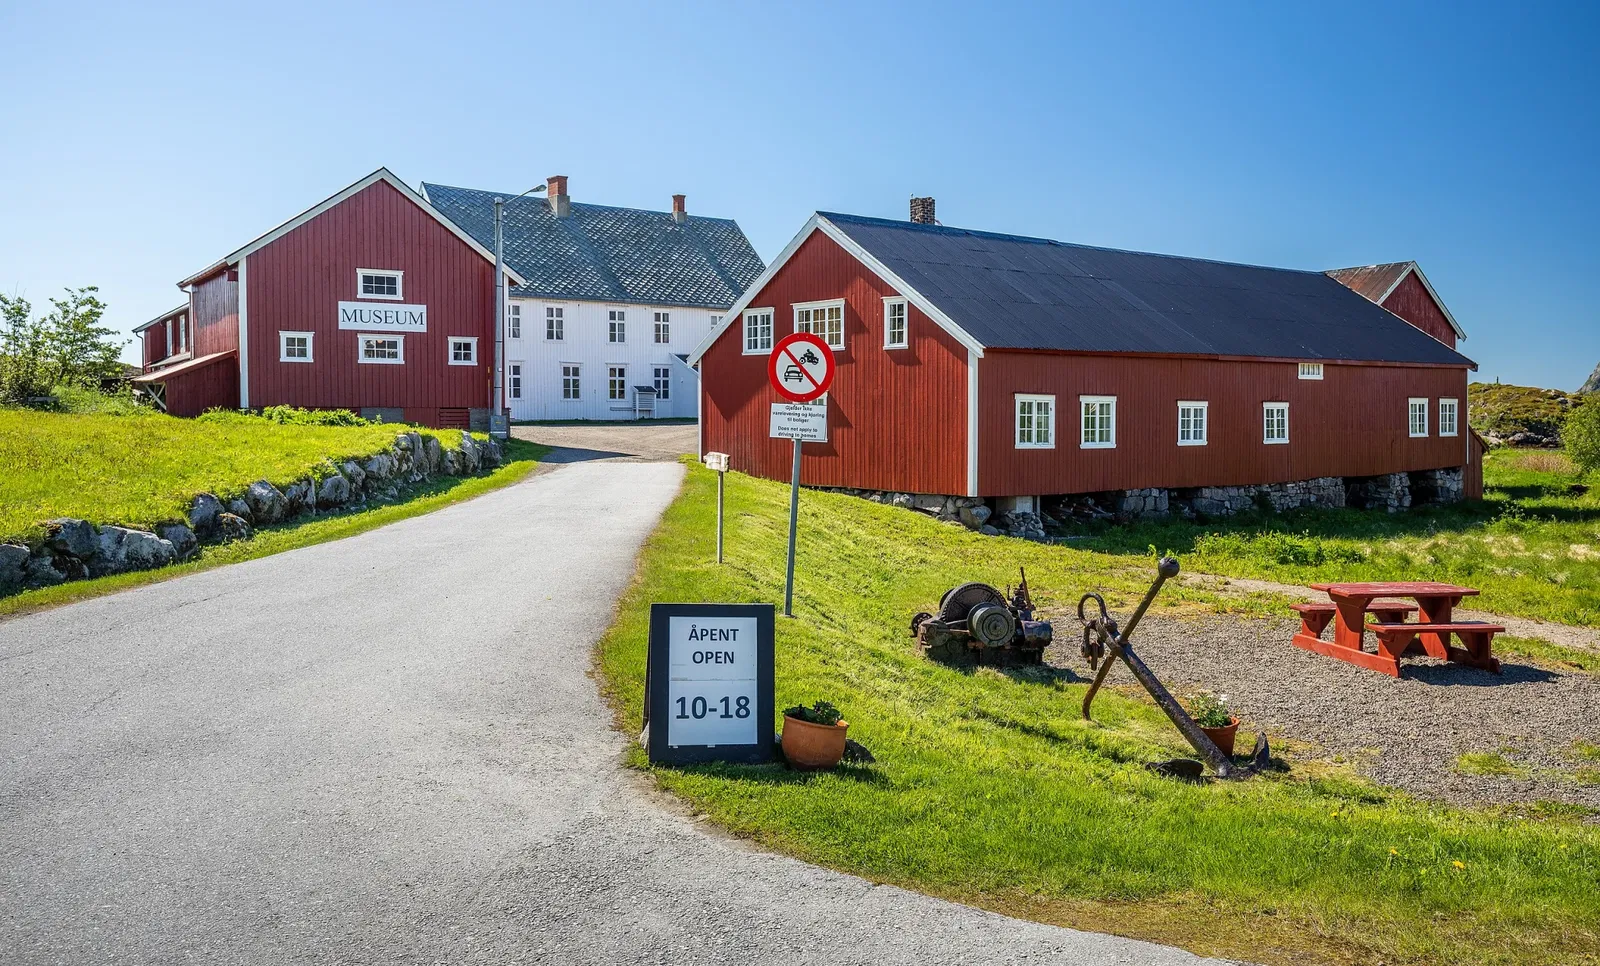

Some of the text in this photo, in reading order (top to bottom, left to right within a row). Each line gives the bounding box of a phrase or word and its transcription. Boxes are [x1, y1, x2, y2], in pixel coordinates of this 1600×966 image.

[341, 308, 424, 326] MUSEUM
[688, 624, 739, 641] ÅPENT
[692, 651, 734, 664] OPEN
[676, 695, 750, 719] 10-18
